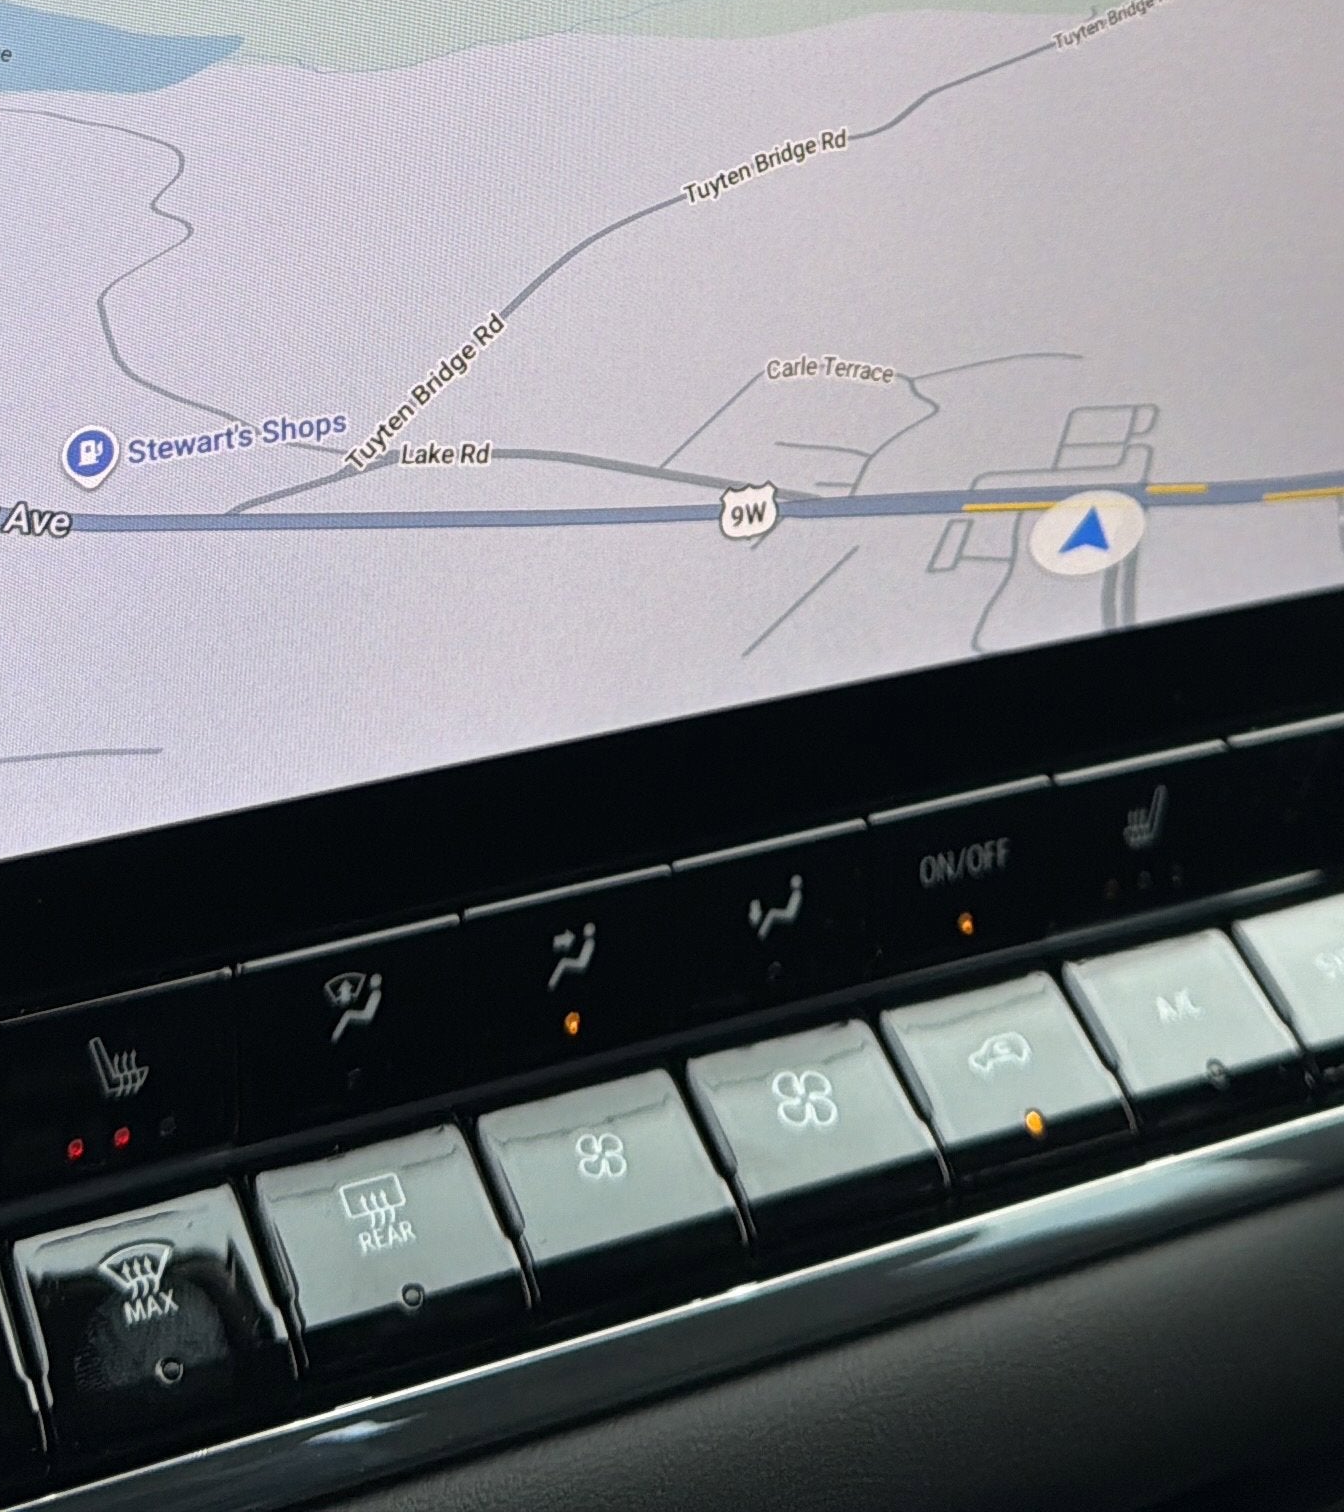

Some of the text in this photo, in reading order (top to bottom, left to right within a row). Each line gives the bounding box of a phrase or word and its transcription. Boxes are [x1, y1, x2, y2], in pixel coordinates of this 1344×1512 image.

[1053, 16, 1106, 50] Tuyten
[683, 129, 848, 204] Tuyten Bridge Rd
[765, 356, 895, 384] Carle Terrace
[345, 312, 506, 471] Tuyten Bridge Rd
[127, 411, 348, 465] Stewart's Shops
[400, 442, 491, 467] Lake Rd
[4, 500, 74, 538] Ave
[730, 501, 768, 528] 9W
[919, 836, 1011, 888] ON/OFF
[358, 1219, 418, 1256] REAR
[123, 1289, 180, 1326] MAX
